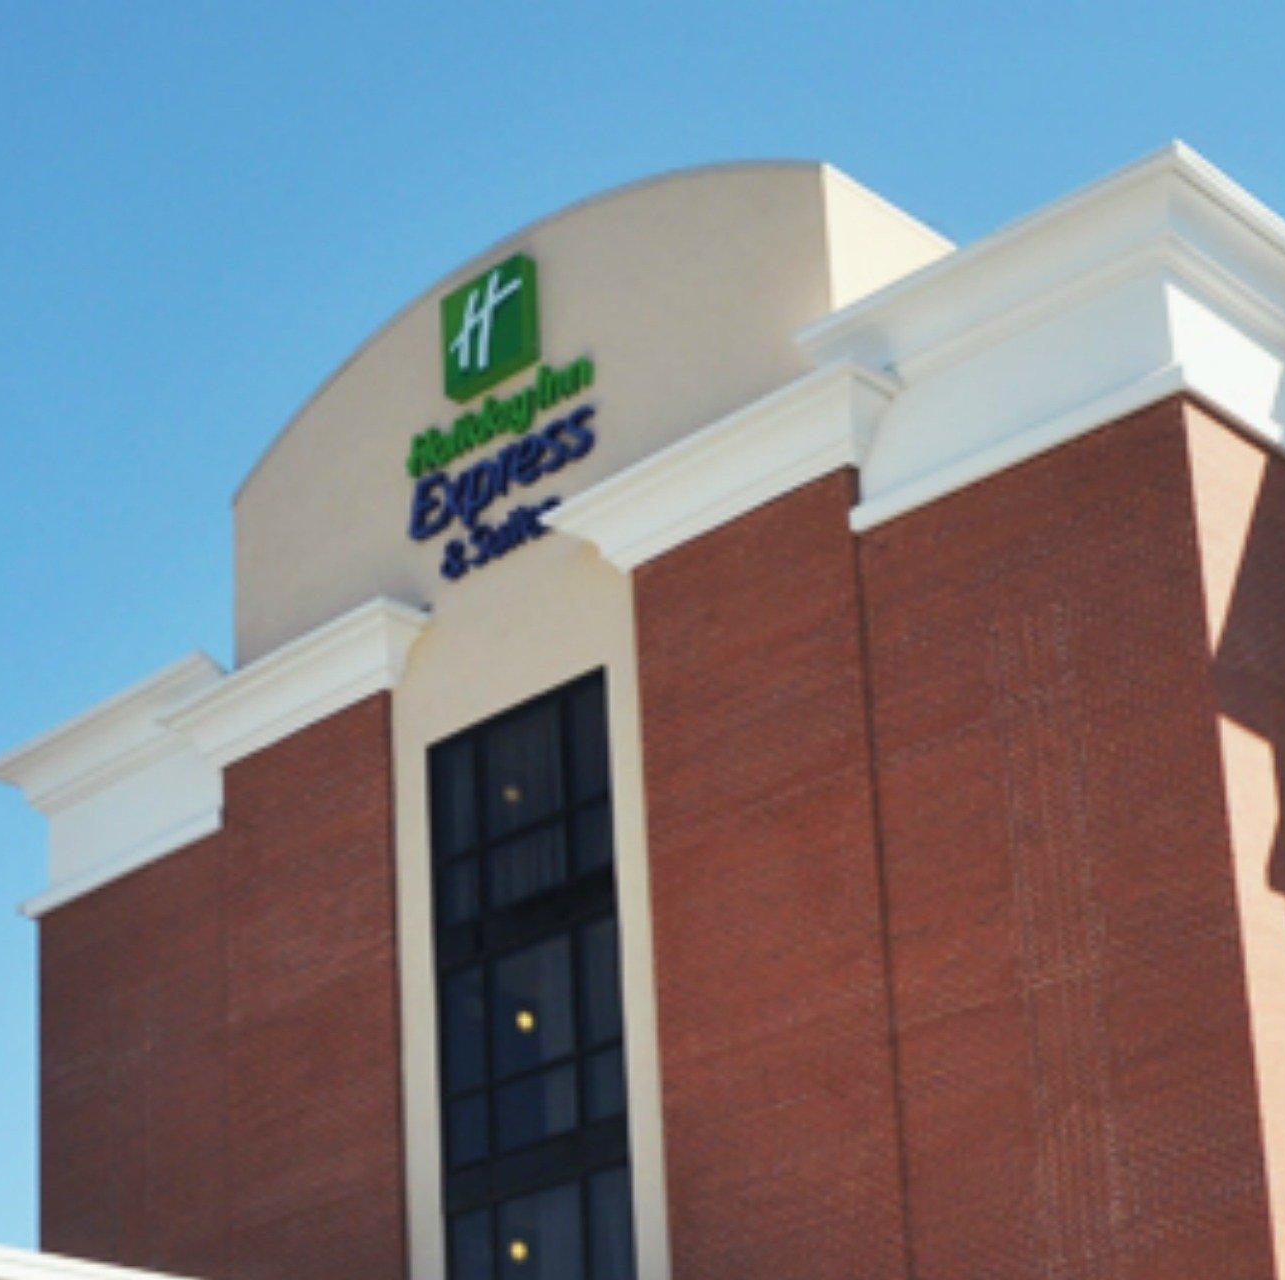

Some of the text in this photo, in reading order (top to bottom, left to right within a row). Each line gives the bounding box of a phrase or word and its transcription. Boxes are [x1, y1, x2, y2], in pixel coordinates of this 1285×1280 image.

[406, 356, 595, 478] Holiday Inn
[410, 404, 596, 541] Express
[441, 539, 470, 580] &
